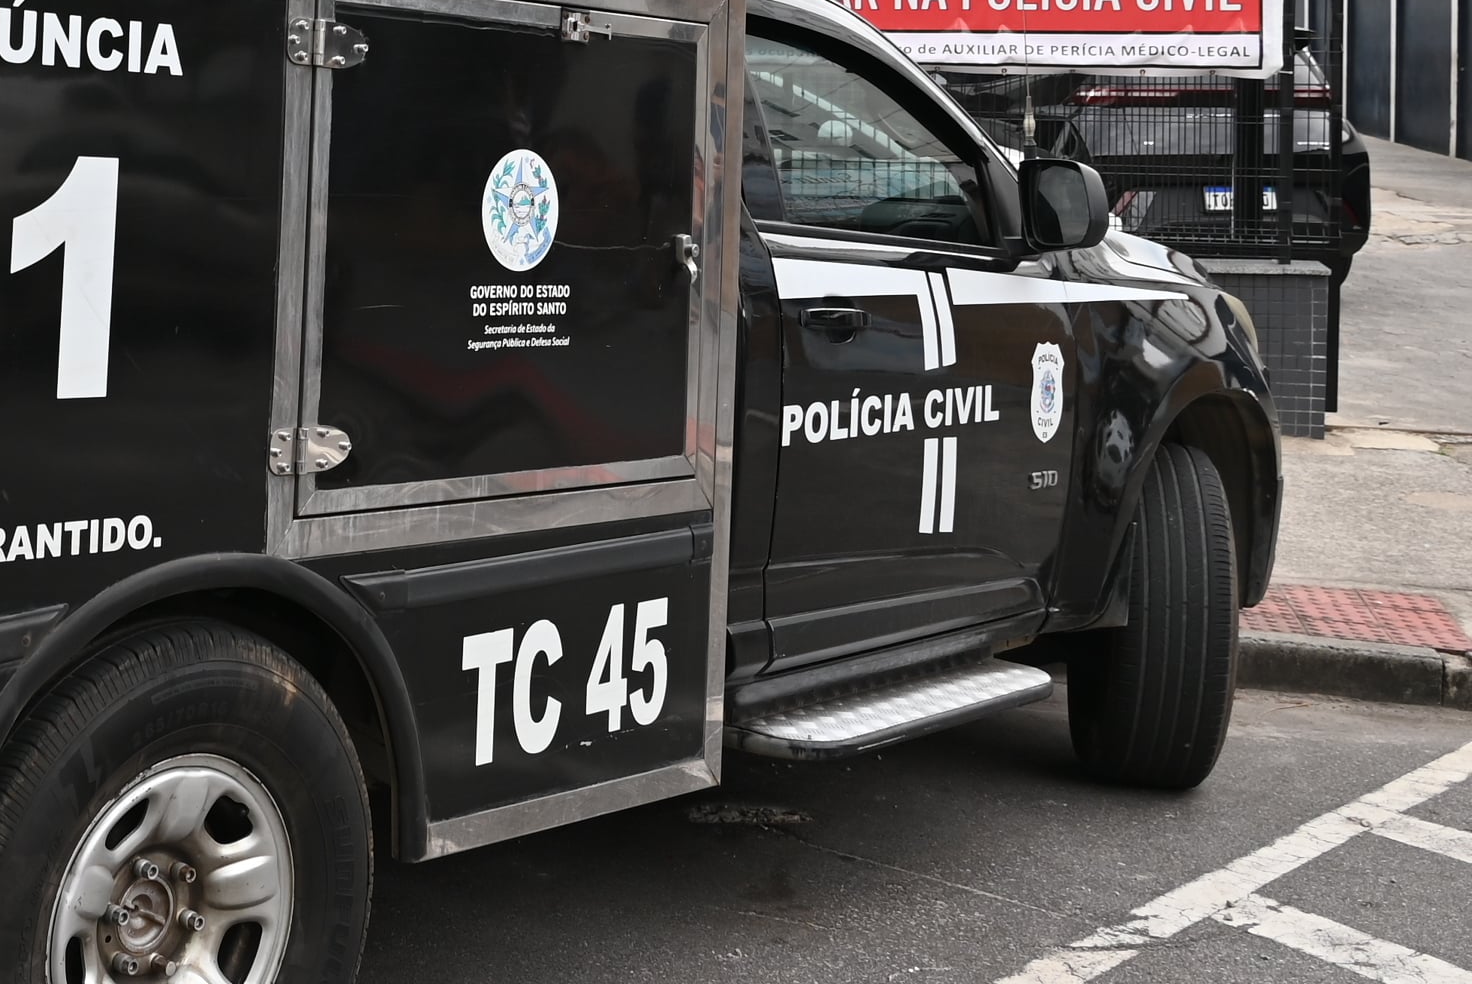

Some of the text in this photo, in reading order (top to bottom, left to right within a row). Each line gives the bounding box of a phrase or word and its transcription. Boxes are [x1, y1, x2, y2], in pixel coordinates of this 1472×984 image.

[918, 42, 937, 55] de
[942, 43, 1018, 55] AUXILIAR
[1024, 43, 1044, 56] DE
[1050, 41, 1115, 57] PERÍCIA
[1121, 41, 1251, 58] MÉDICO-LEGAL
[470, 285, 570, 299] GOVERNO DO ESTADO
[473, 299, 567, 316] DO ESPÍRITO SANTO
[782, 384, 1000, 447] POLÍCIA CIVIL
[462, 596, 669, 767] TC 45
